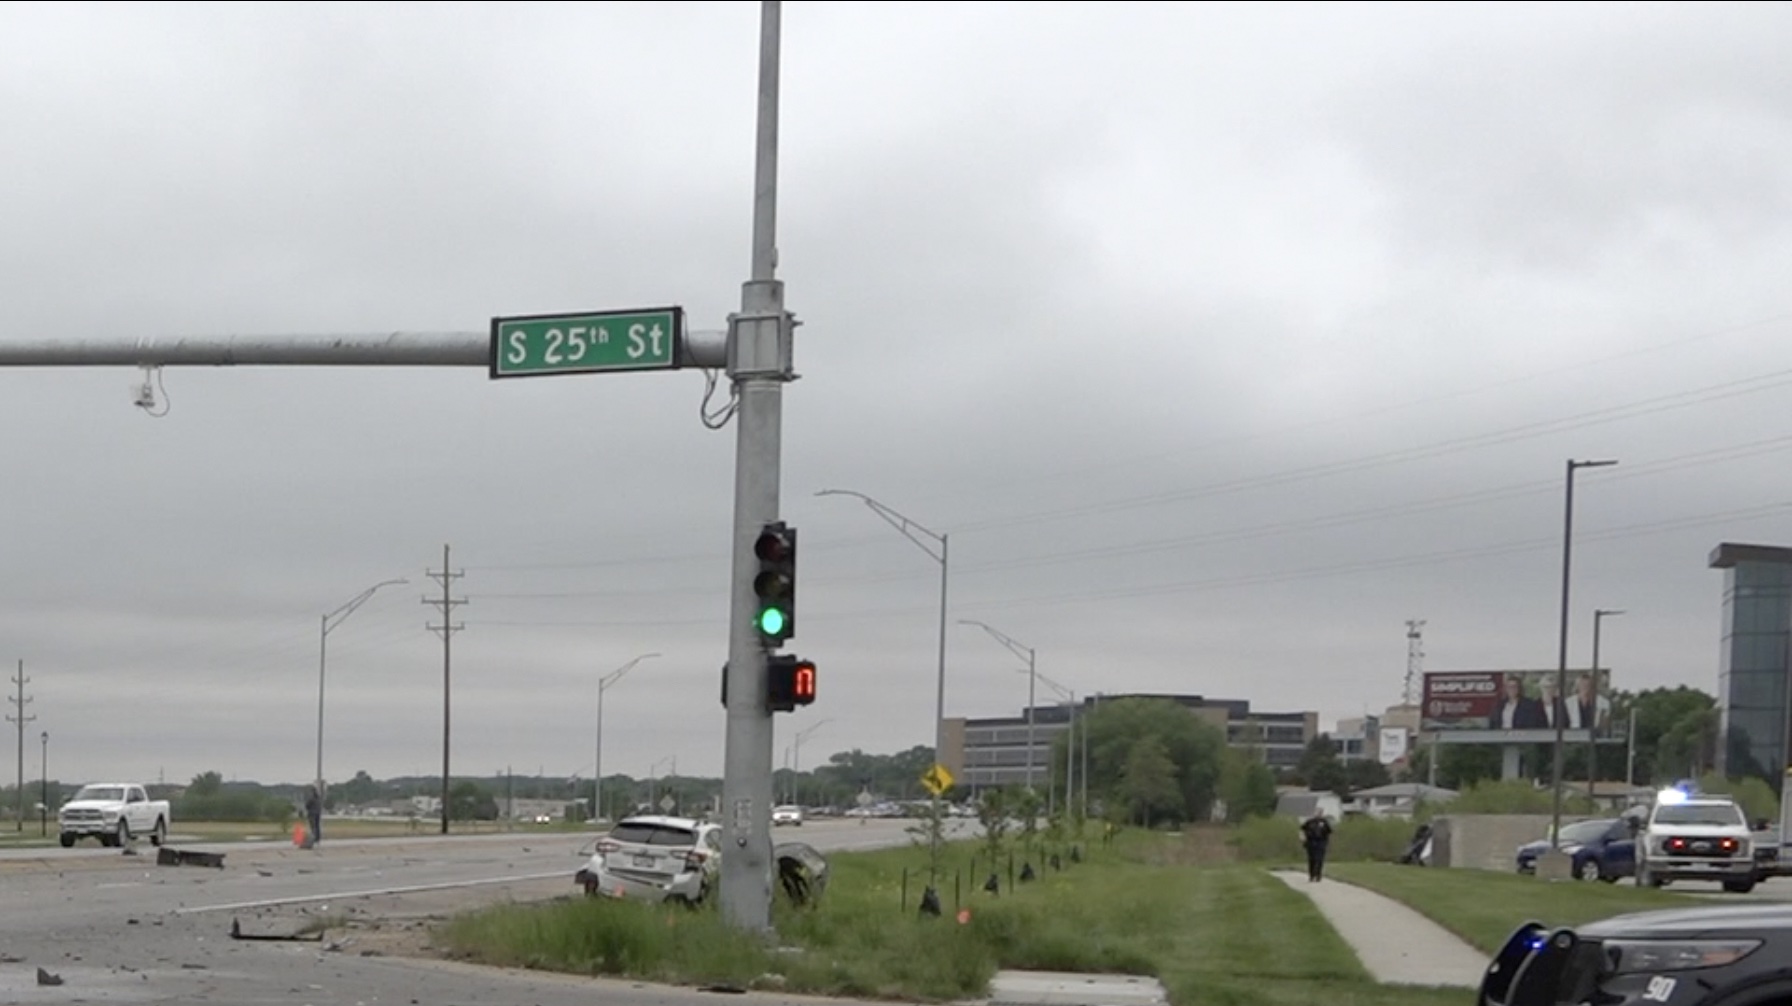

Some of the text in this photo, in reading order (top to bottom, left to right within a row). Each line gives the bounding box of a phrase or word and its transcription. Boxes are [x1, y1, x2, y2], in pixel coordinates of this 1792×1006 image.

[508, 322, 663, 364] S 25th St
[1642, 975, 1677, 1002] 90
